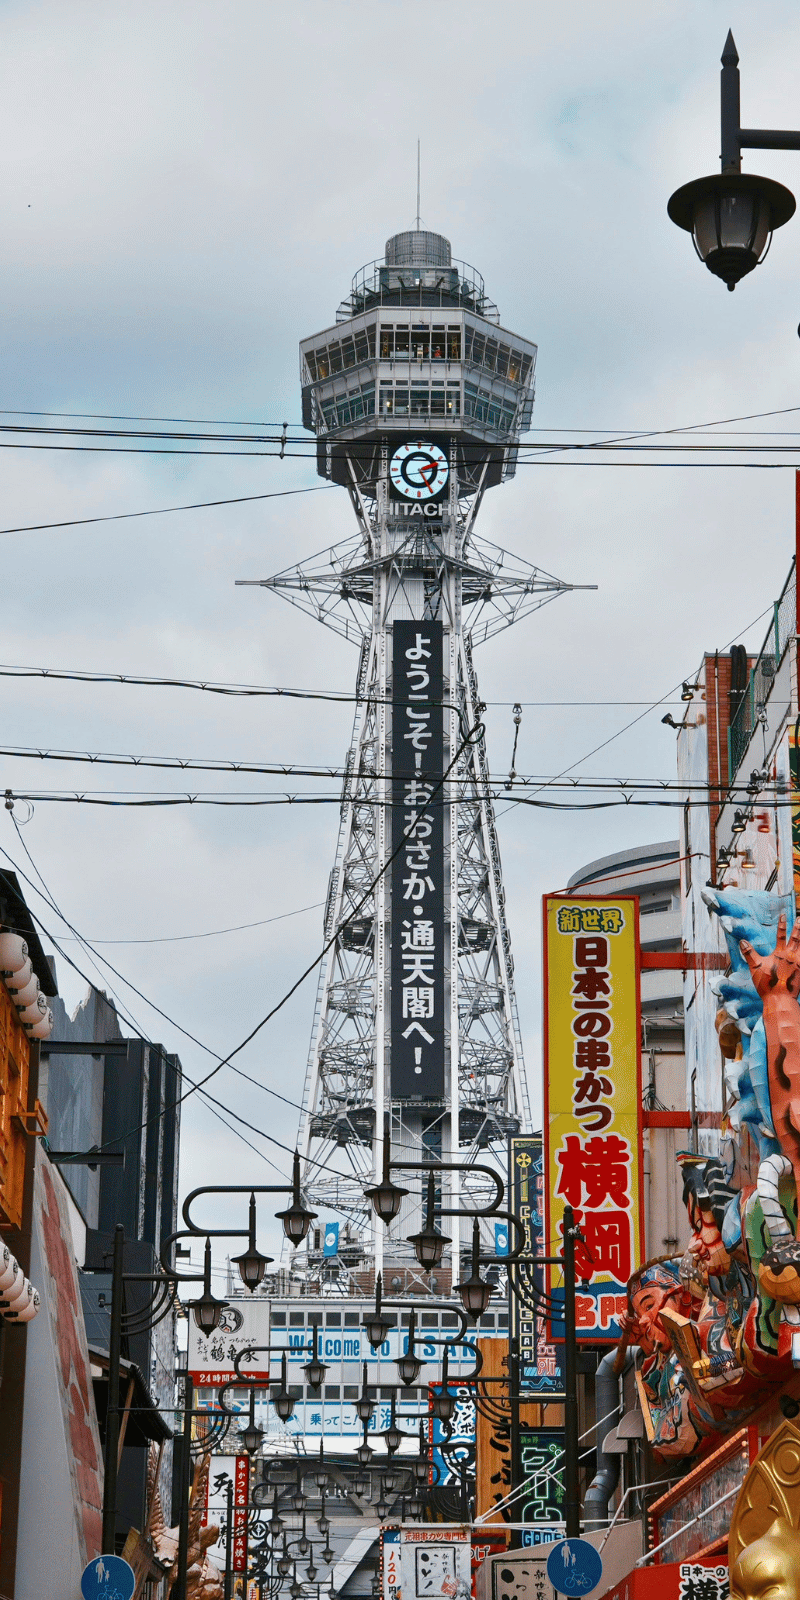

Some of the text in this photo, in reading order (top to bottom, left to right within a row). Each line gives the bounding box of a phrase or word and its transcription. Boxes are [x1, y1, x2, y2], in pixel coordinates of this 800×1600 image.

[380, 503, 457, 516] HITACHI
[558, 908, 624, 933] 新世界
[571, 936, 614, 1132] 日本一の串かつ
[557, 1134, 631, 1284] 横綱
[289, 1335, 360, 1357] Welcome
[403, 1335, 477, 1358] OSAK
[522, 1322, 531, 1360] LAB
[681, 1566, 729, 1577] 日本一の
